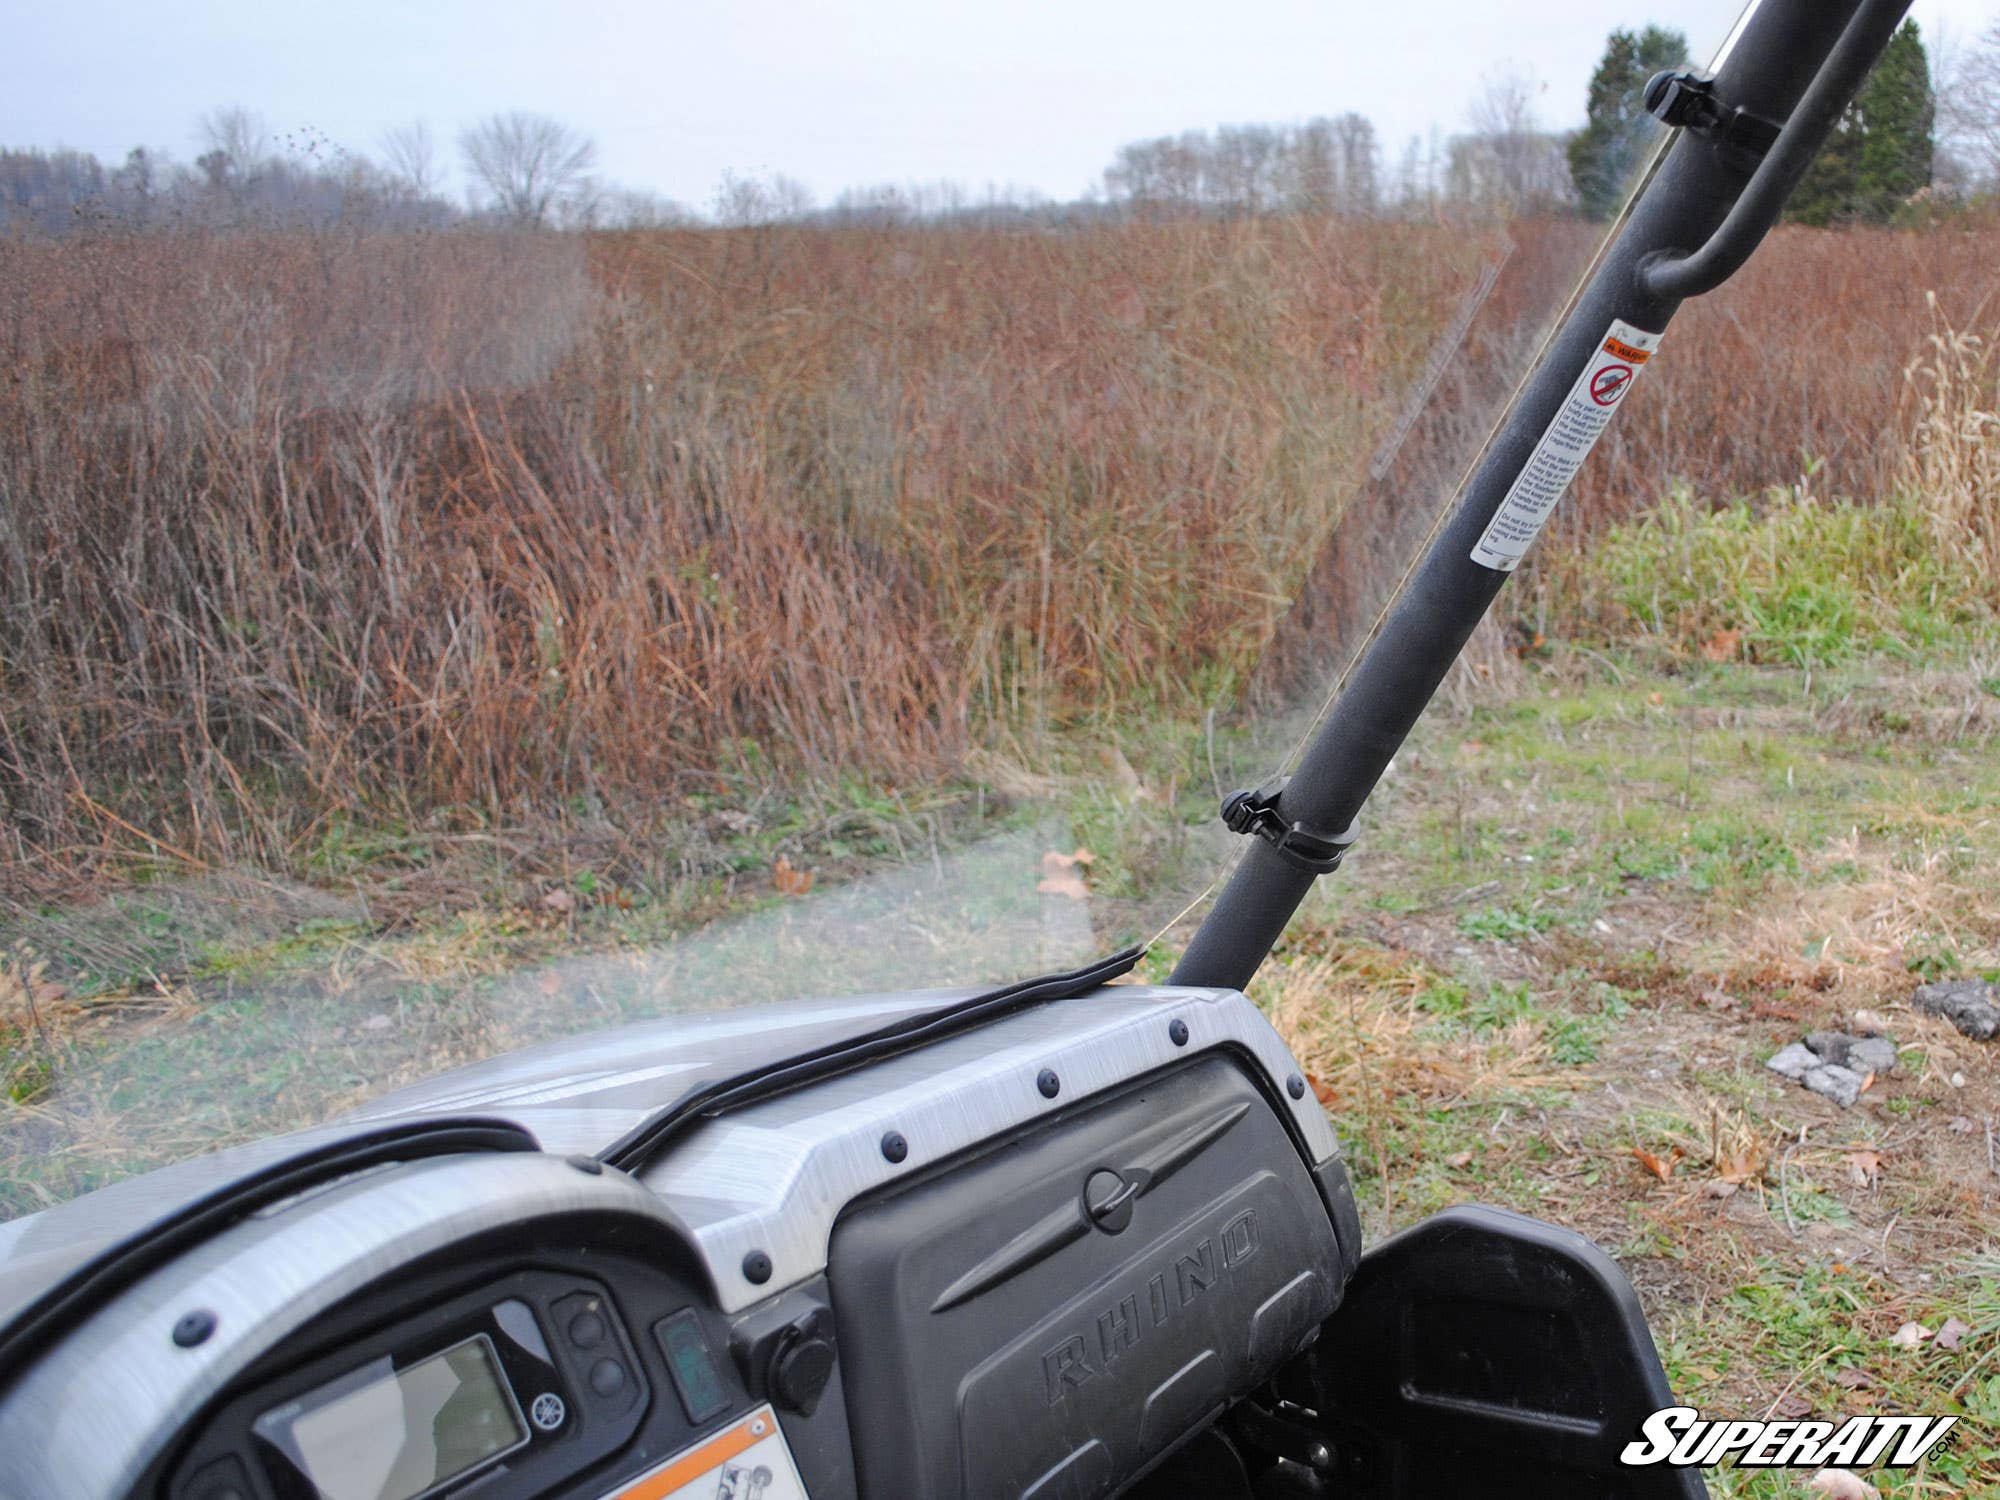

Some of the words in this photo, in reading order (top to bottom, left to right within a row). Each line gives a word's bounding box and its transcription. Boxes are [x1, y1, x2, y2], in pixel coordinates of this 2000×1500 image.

[1572, 399, 1584, 408] Any
[1532, 491, 1545, 500] keep
[1502, 511, 1511, 520] Do
[1042, 1208, 1261, 1408] RHINO
